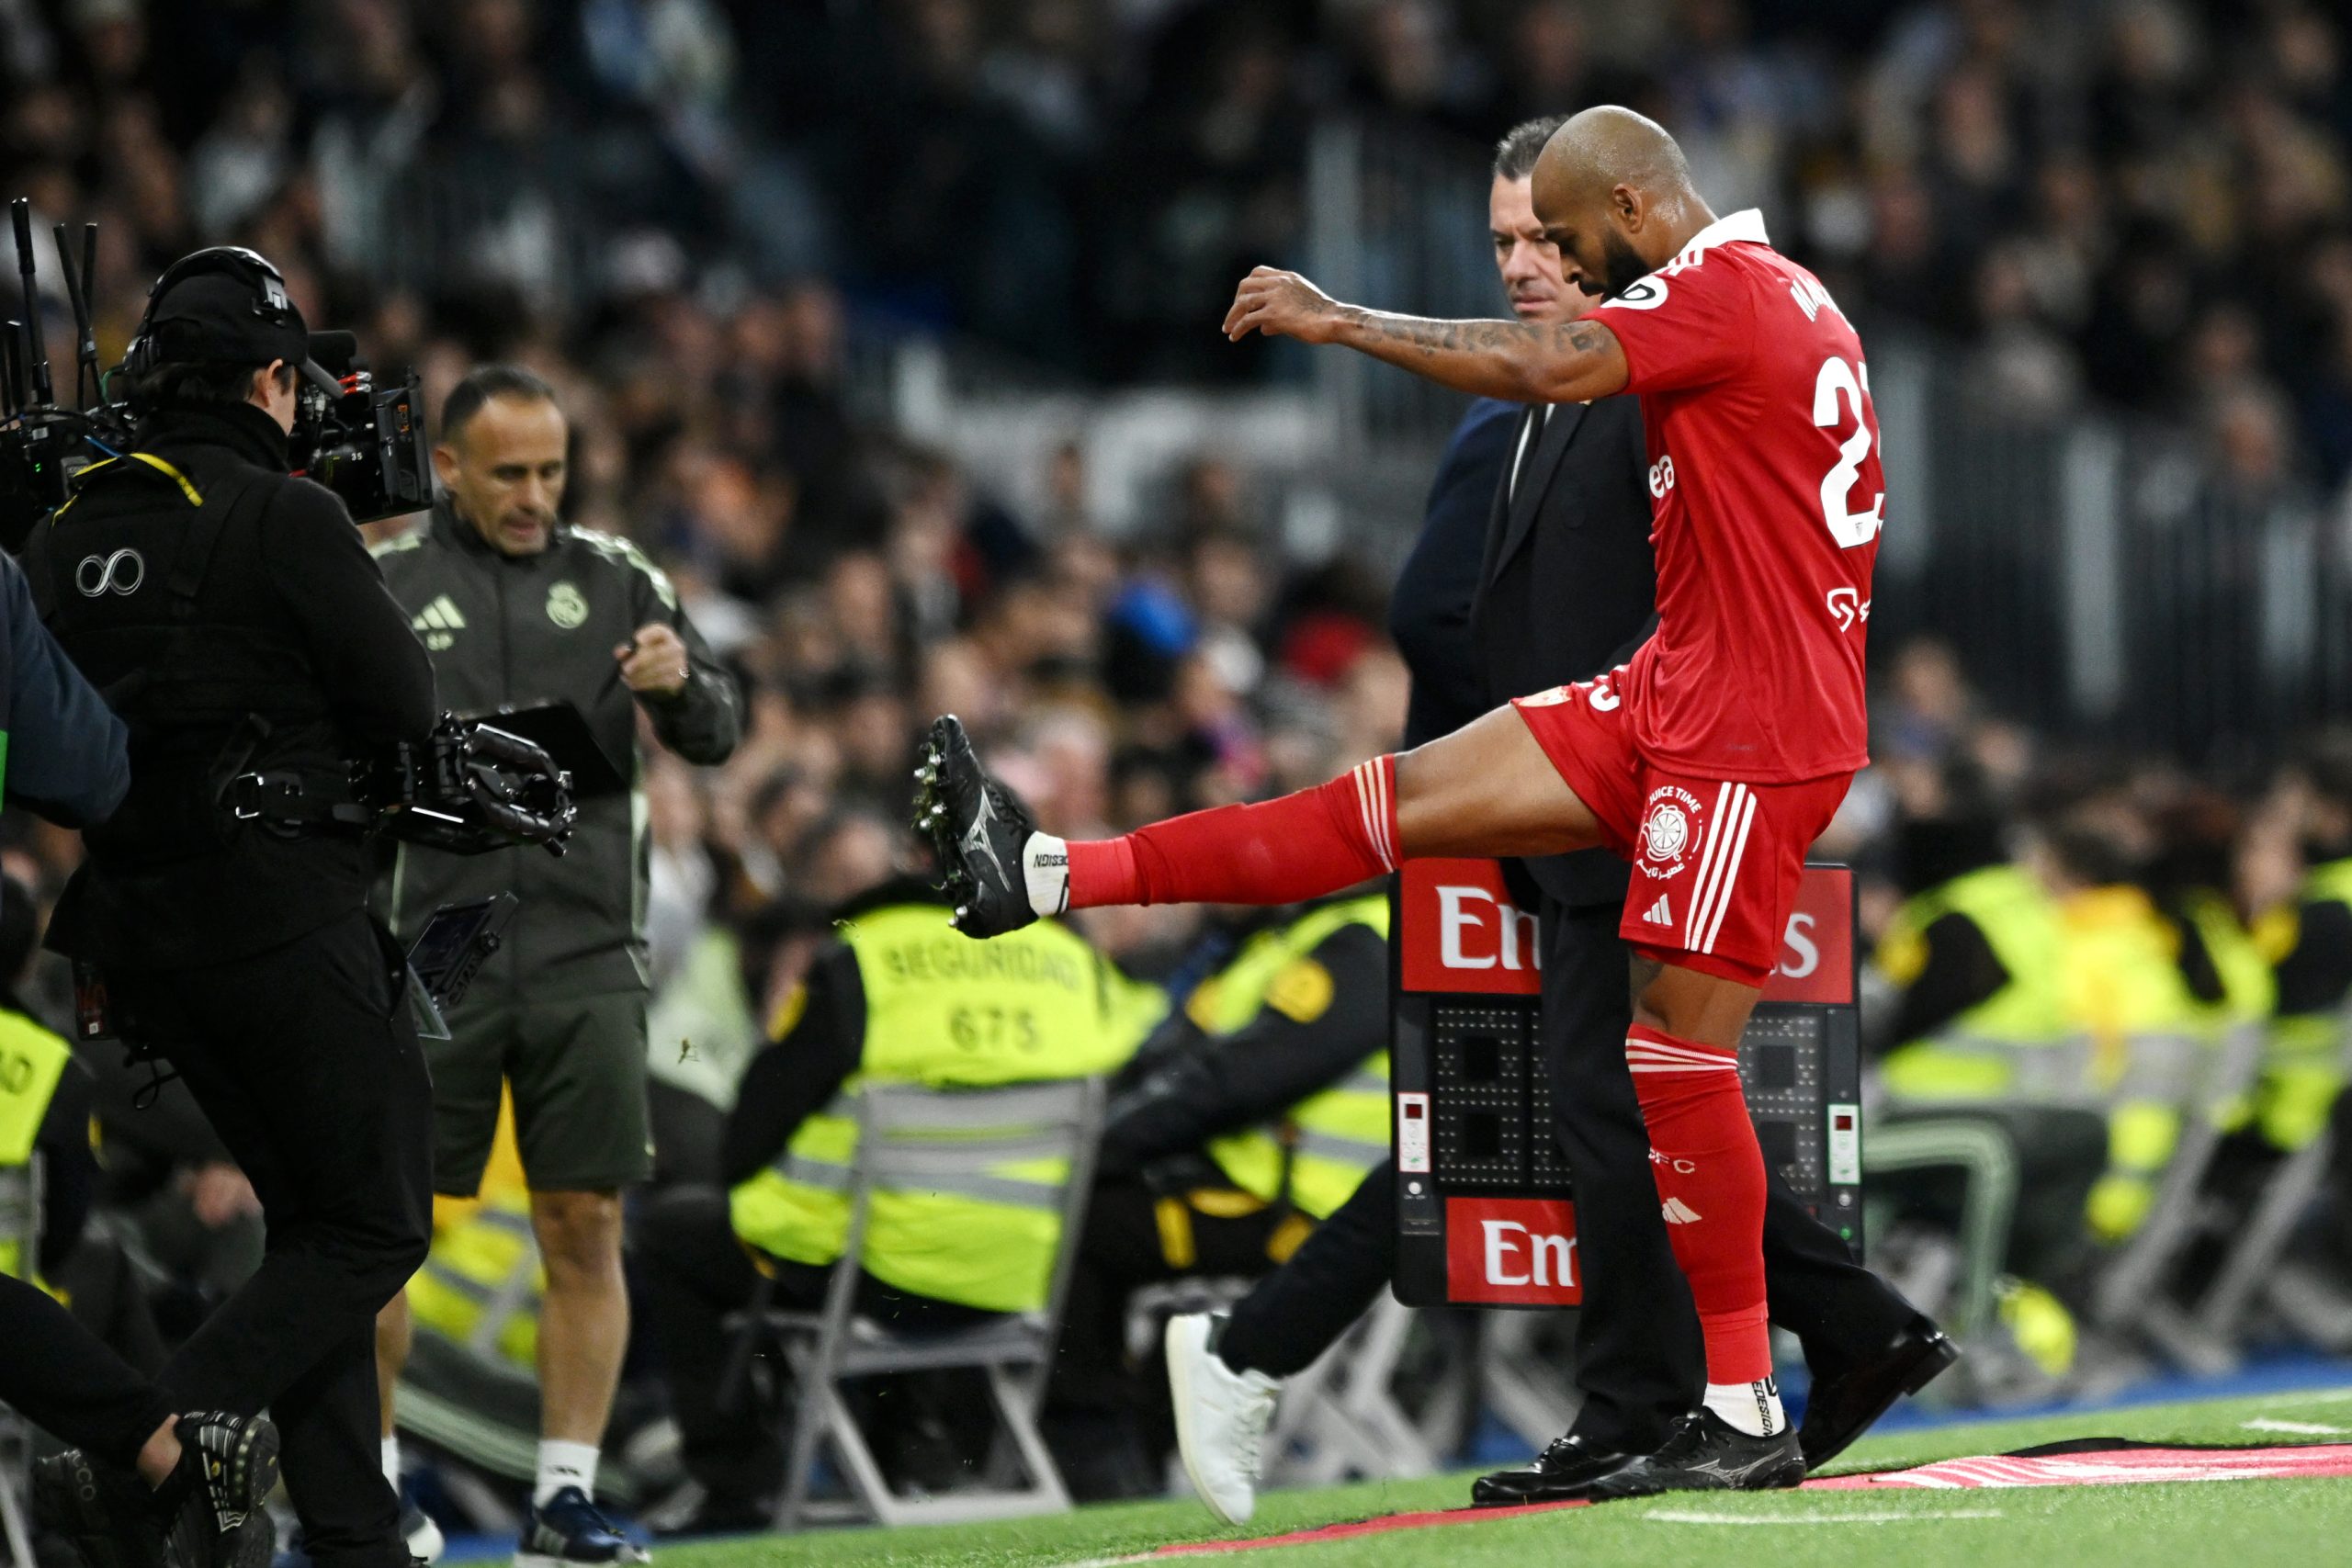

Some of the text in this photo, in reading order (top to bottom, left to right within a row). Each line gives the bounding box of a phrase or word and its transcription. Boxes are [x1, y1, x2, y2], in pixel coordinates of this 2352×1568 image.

[351, 452, 364, 461] 35
[1813, 355, 1885, 549] 2
[1649, 786, 1702, 814] JUICE TIME
